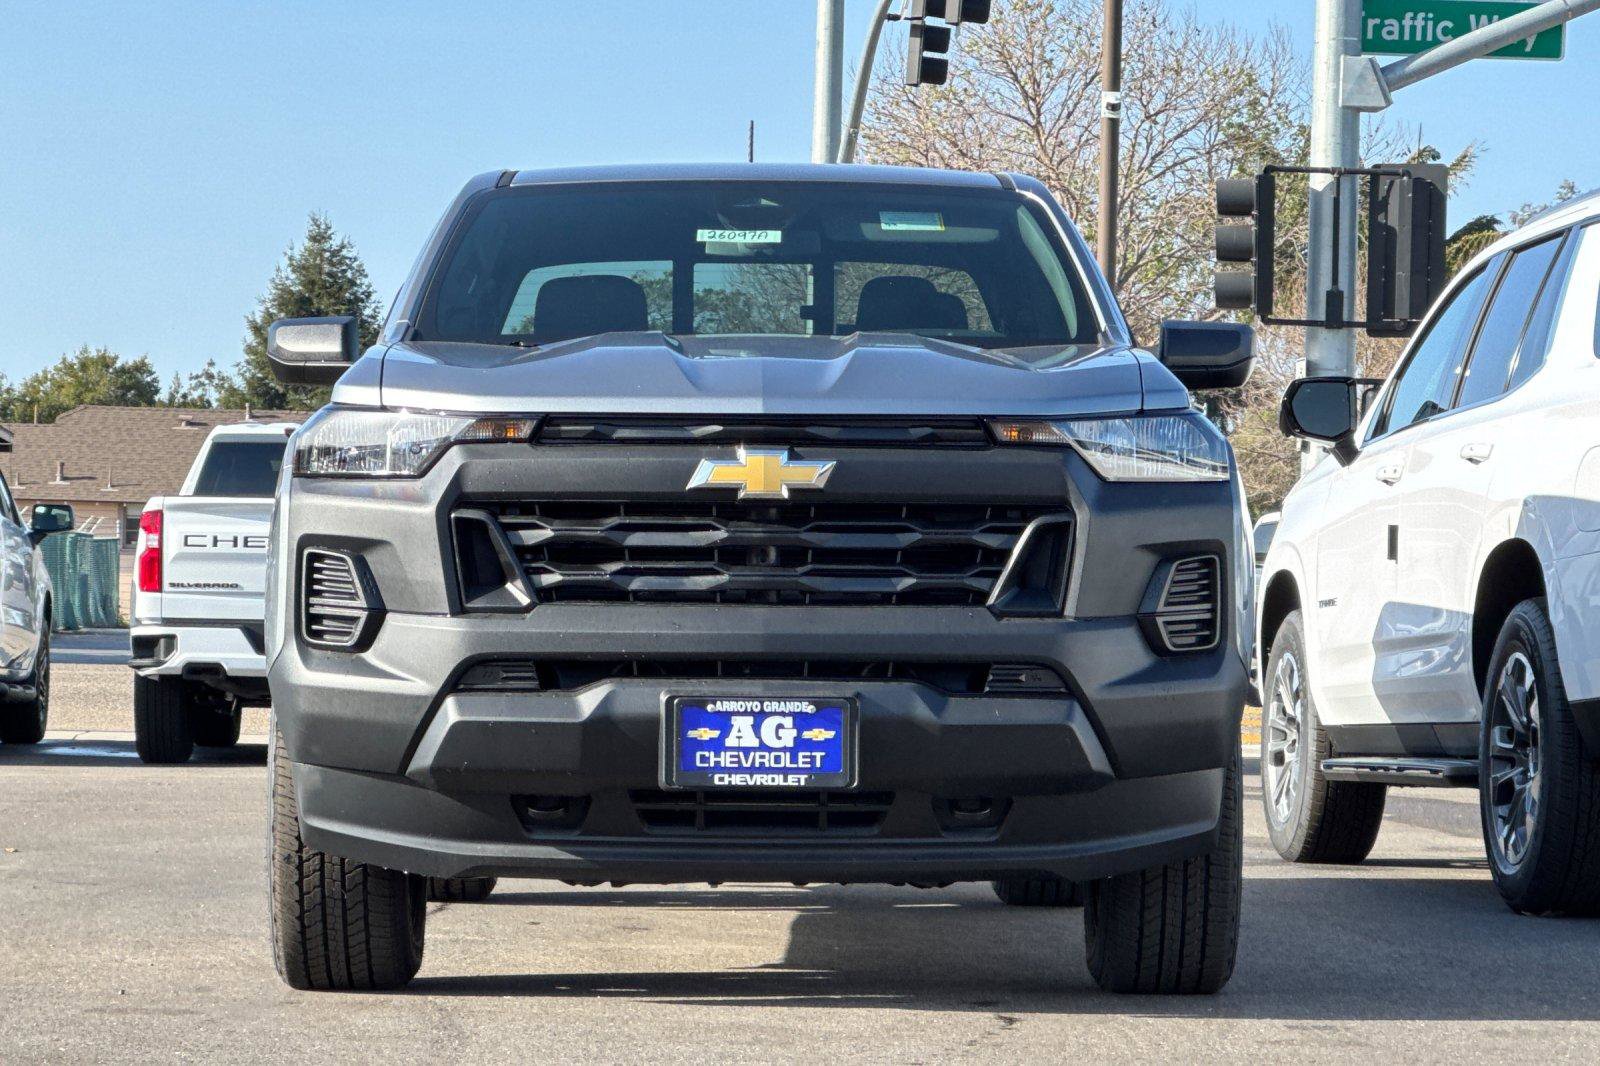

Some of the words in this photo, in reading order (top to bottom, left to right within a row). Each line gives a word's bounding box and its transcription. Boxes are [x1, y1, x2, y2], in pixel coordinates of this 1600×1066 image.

[1362, 11, 1454, 41] raffic
[168, 582, 240, 590] SILVERADO
[716, 701, 760, 712] ARROYO
[764, 701, 808, 712] GRANDE
[725, 715, 797, 748] AG
[696, 751, 825, 768] CHEVROLET
[714, 773, 808, 785] CHEVROLET
